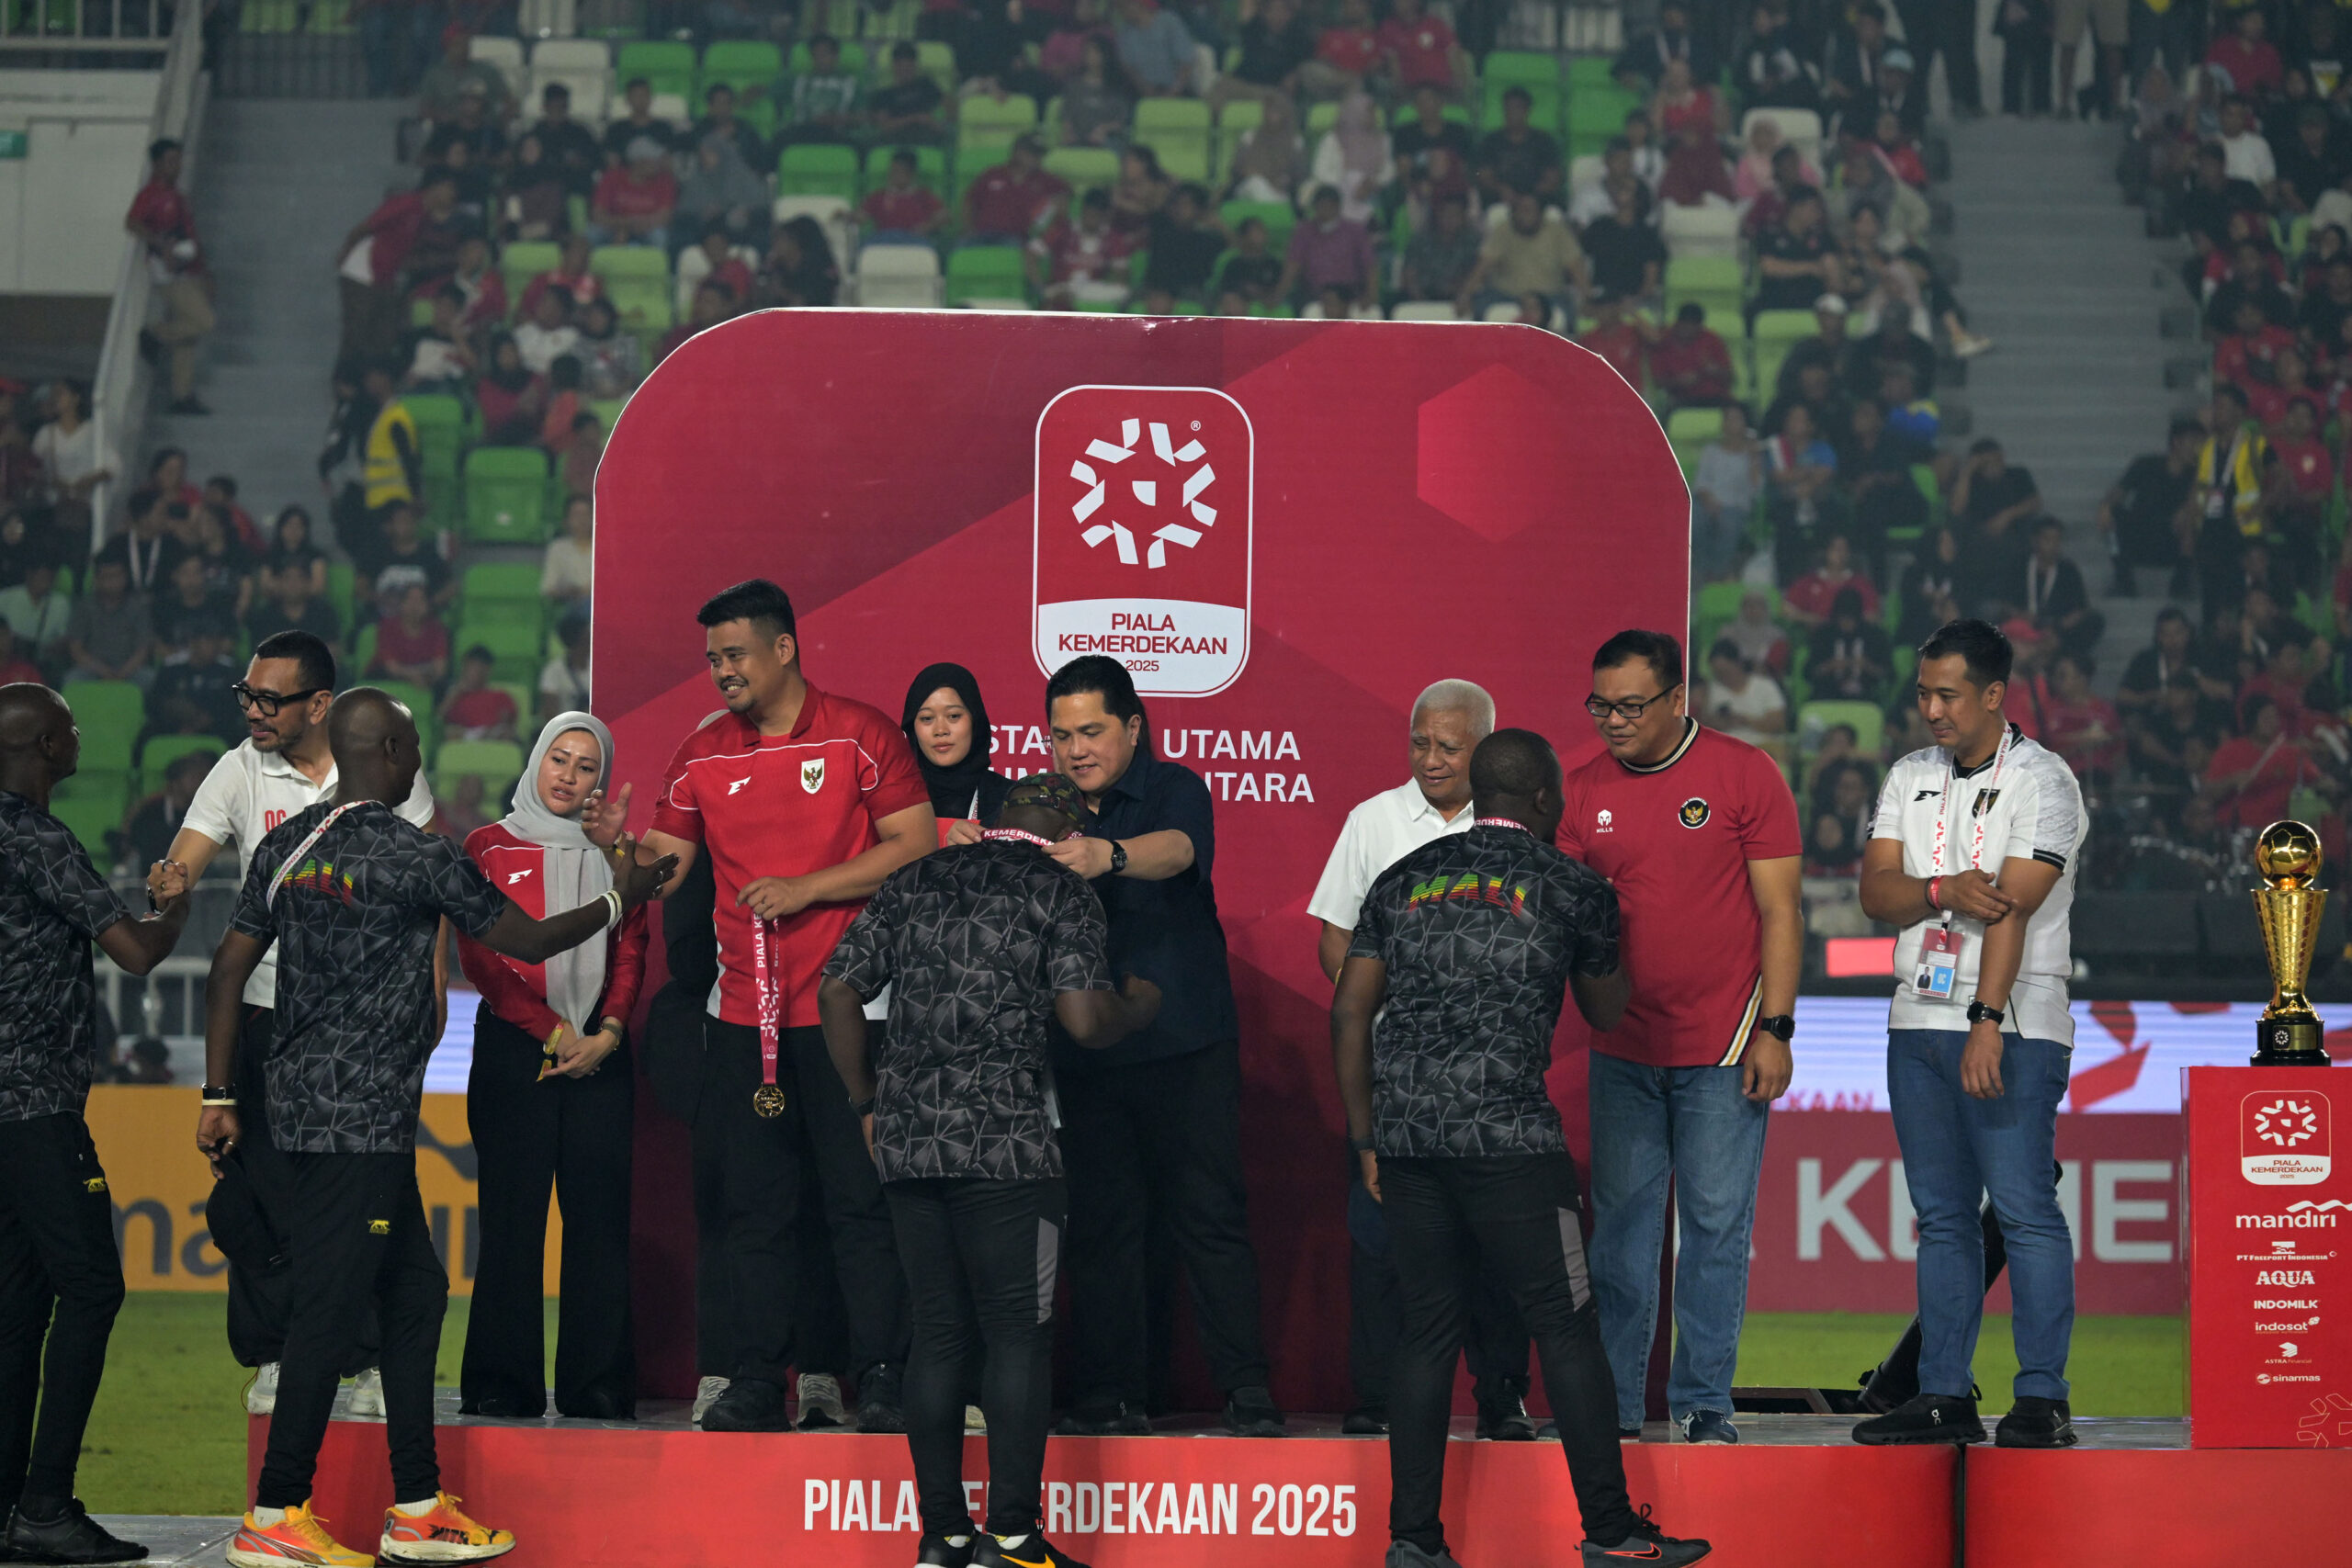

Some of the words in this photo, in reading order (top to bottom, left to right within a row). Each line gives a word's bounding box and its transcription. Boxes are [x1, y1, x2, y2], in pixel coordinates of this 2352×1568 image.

[1111, 613, 1176, 632] PIALA
[1058, 634, 1227, 655] KEMERDEKAAN
[1125, 659, 1159, 672] 2025
[1162, 728, 1301, 761] UTAMA
[1408, 874, 1527, 917] MALI
[755, 932, 766, 968] PIALA
[2235, 1210, 2336, 1228] mandiri
[2256, 1270, 2315, 1288] AQUA
[2254, 1300, 2318, 1309] INDOMILK
[2255, 1322, 2308, 1331] indosat
[803, 1478, 919, 1532] PIALA
[1250, 1483, 1357, 1537] 2025
